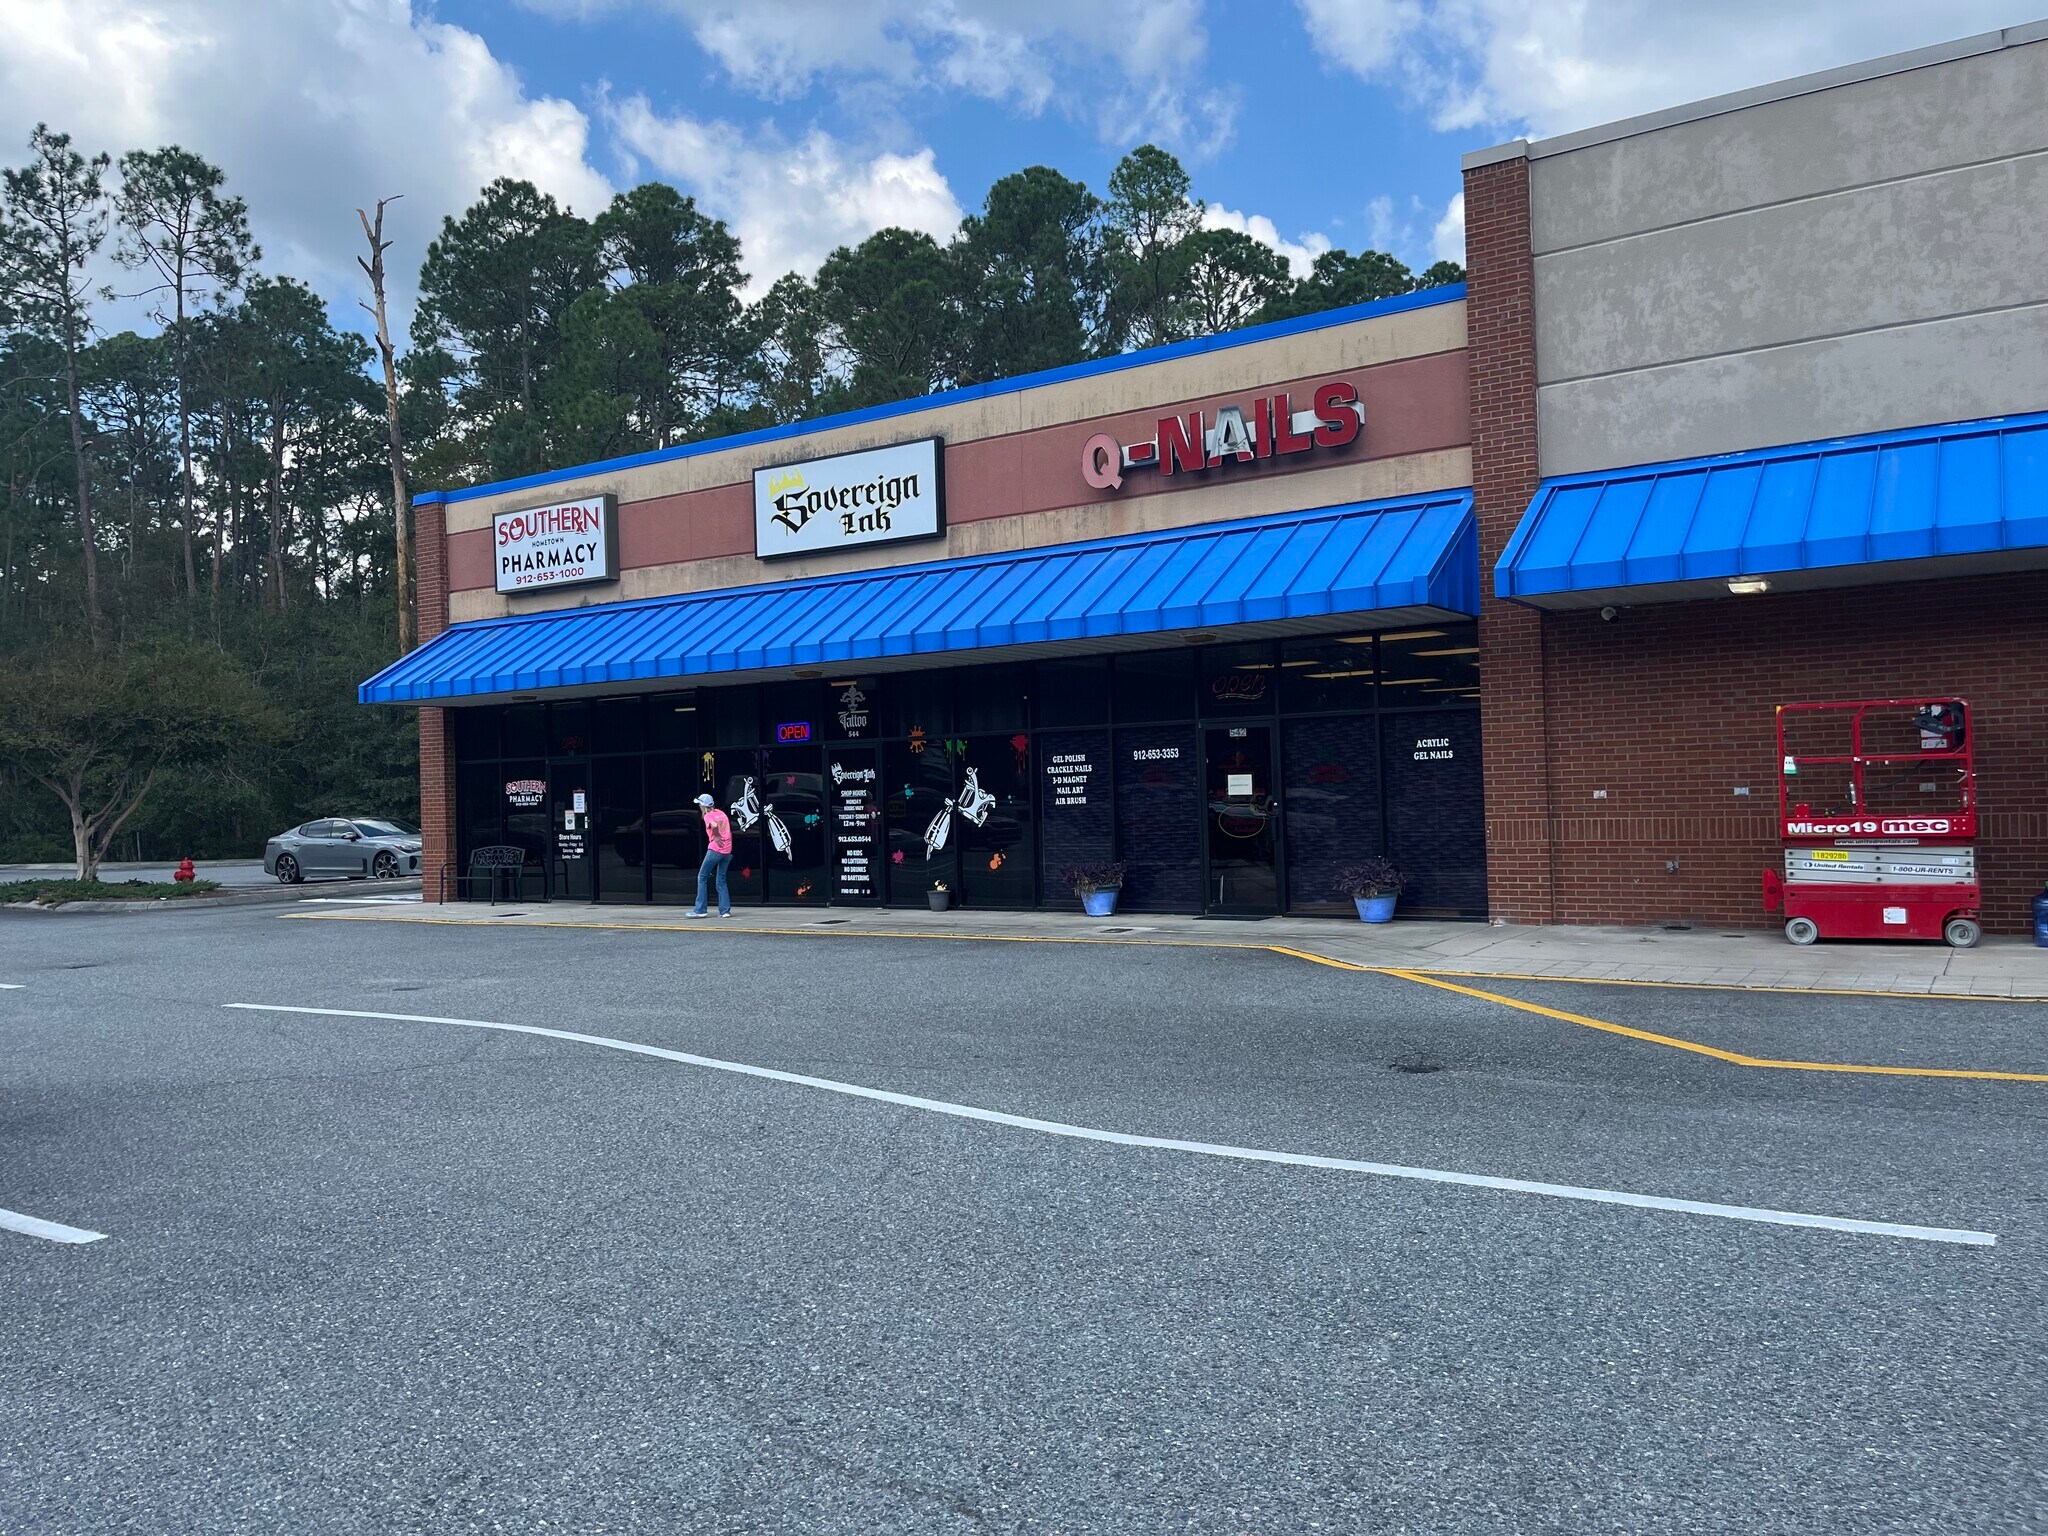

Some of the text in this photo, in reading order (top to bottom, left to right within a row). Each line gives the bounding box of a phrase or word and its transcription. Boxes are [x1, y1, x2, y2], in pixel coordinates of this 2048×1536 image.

[1082, 382, 1359, 490] Q-NAILS
[770, 474, 921, 534] Sovereign
[498, 506, 600, 546] SOUTHERN
[839, 506, 891, 536] Ink
[532, 537, 564, 547] HOMETOWN
[502, 542, 597, 574] PHARMACY
[516, 567, 584, 584] 912-653-1000
[838, 711, 867, 731] Tattoo
[780, 725, 808, 740] OPEN
[1416, 738, 1449, 748] ACRYLIC
[1065, 754, 1085, 762] POLISH
[1133, 748, 1179, 760] 912-653-3353
[1413, 750, 1454, 760] GEL NAILS
[1047, 764, 1092, 774] CRACKLE NAILS
[1072, 786, 1084, 794] ART
[1055, 796, 1086, 805] AIR BRUSH
[1787, 821, 1948, 833] Micro19 mec
